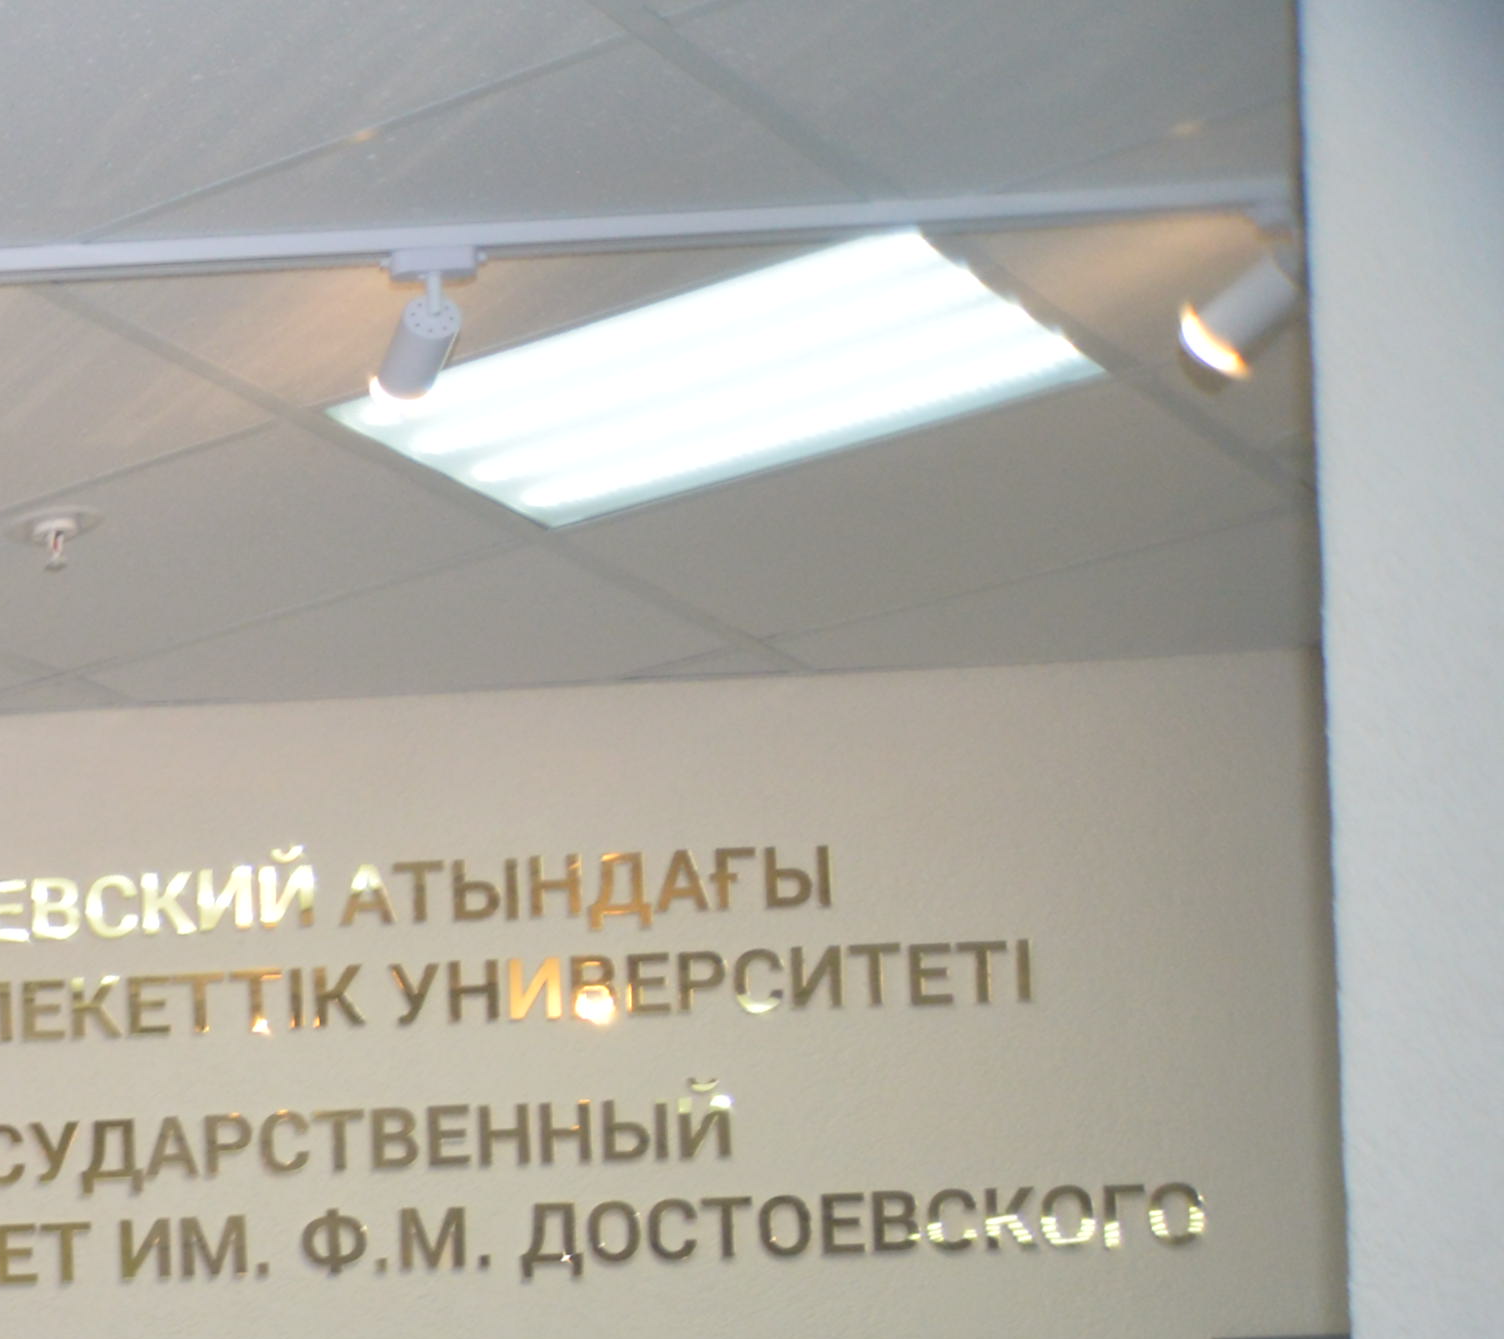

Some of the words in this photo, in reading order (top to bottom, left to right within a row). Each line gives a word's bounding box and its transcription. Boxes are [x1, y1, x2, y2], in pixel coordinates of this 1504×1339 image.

[341, 844, 833, 931] АТЫНДАҒЫ
[390, 938, 1033, 1026] УНИВЕРСИТЕТІ
[118, 1213, 271, 1282] ИМ.
[300, 1205, 492, 1275] Ф.М.
[519, 1180, 1207, 1282] ДОСТОЕВСКОГО
